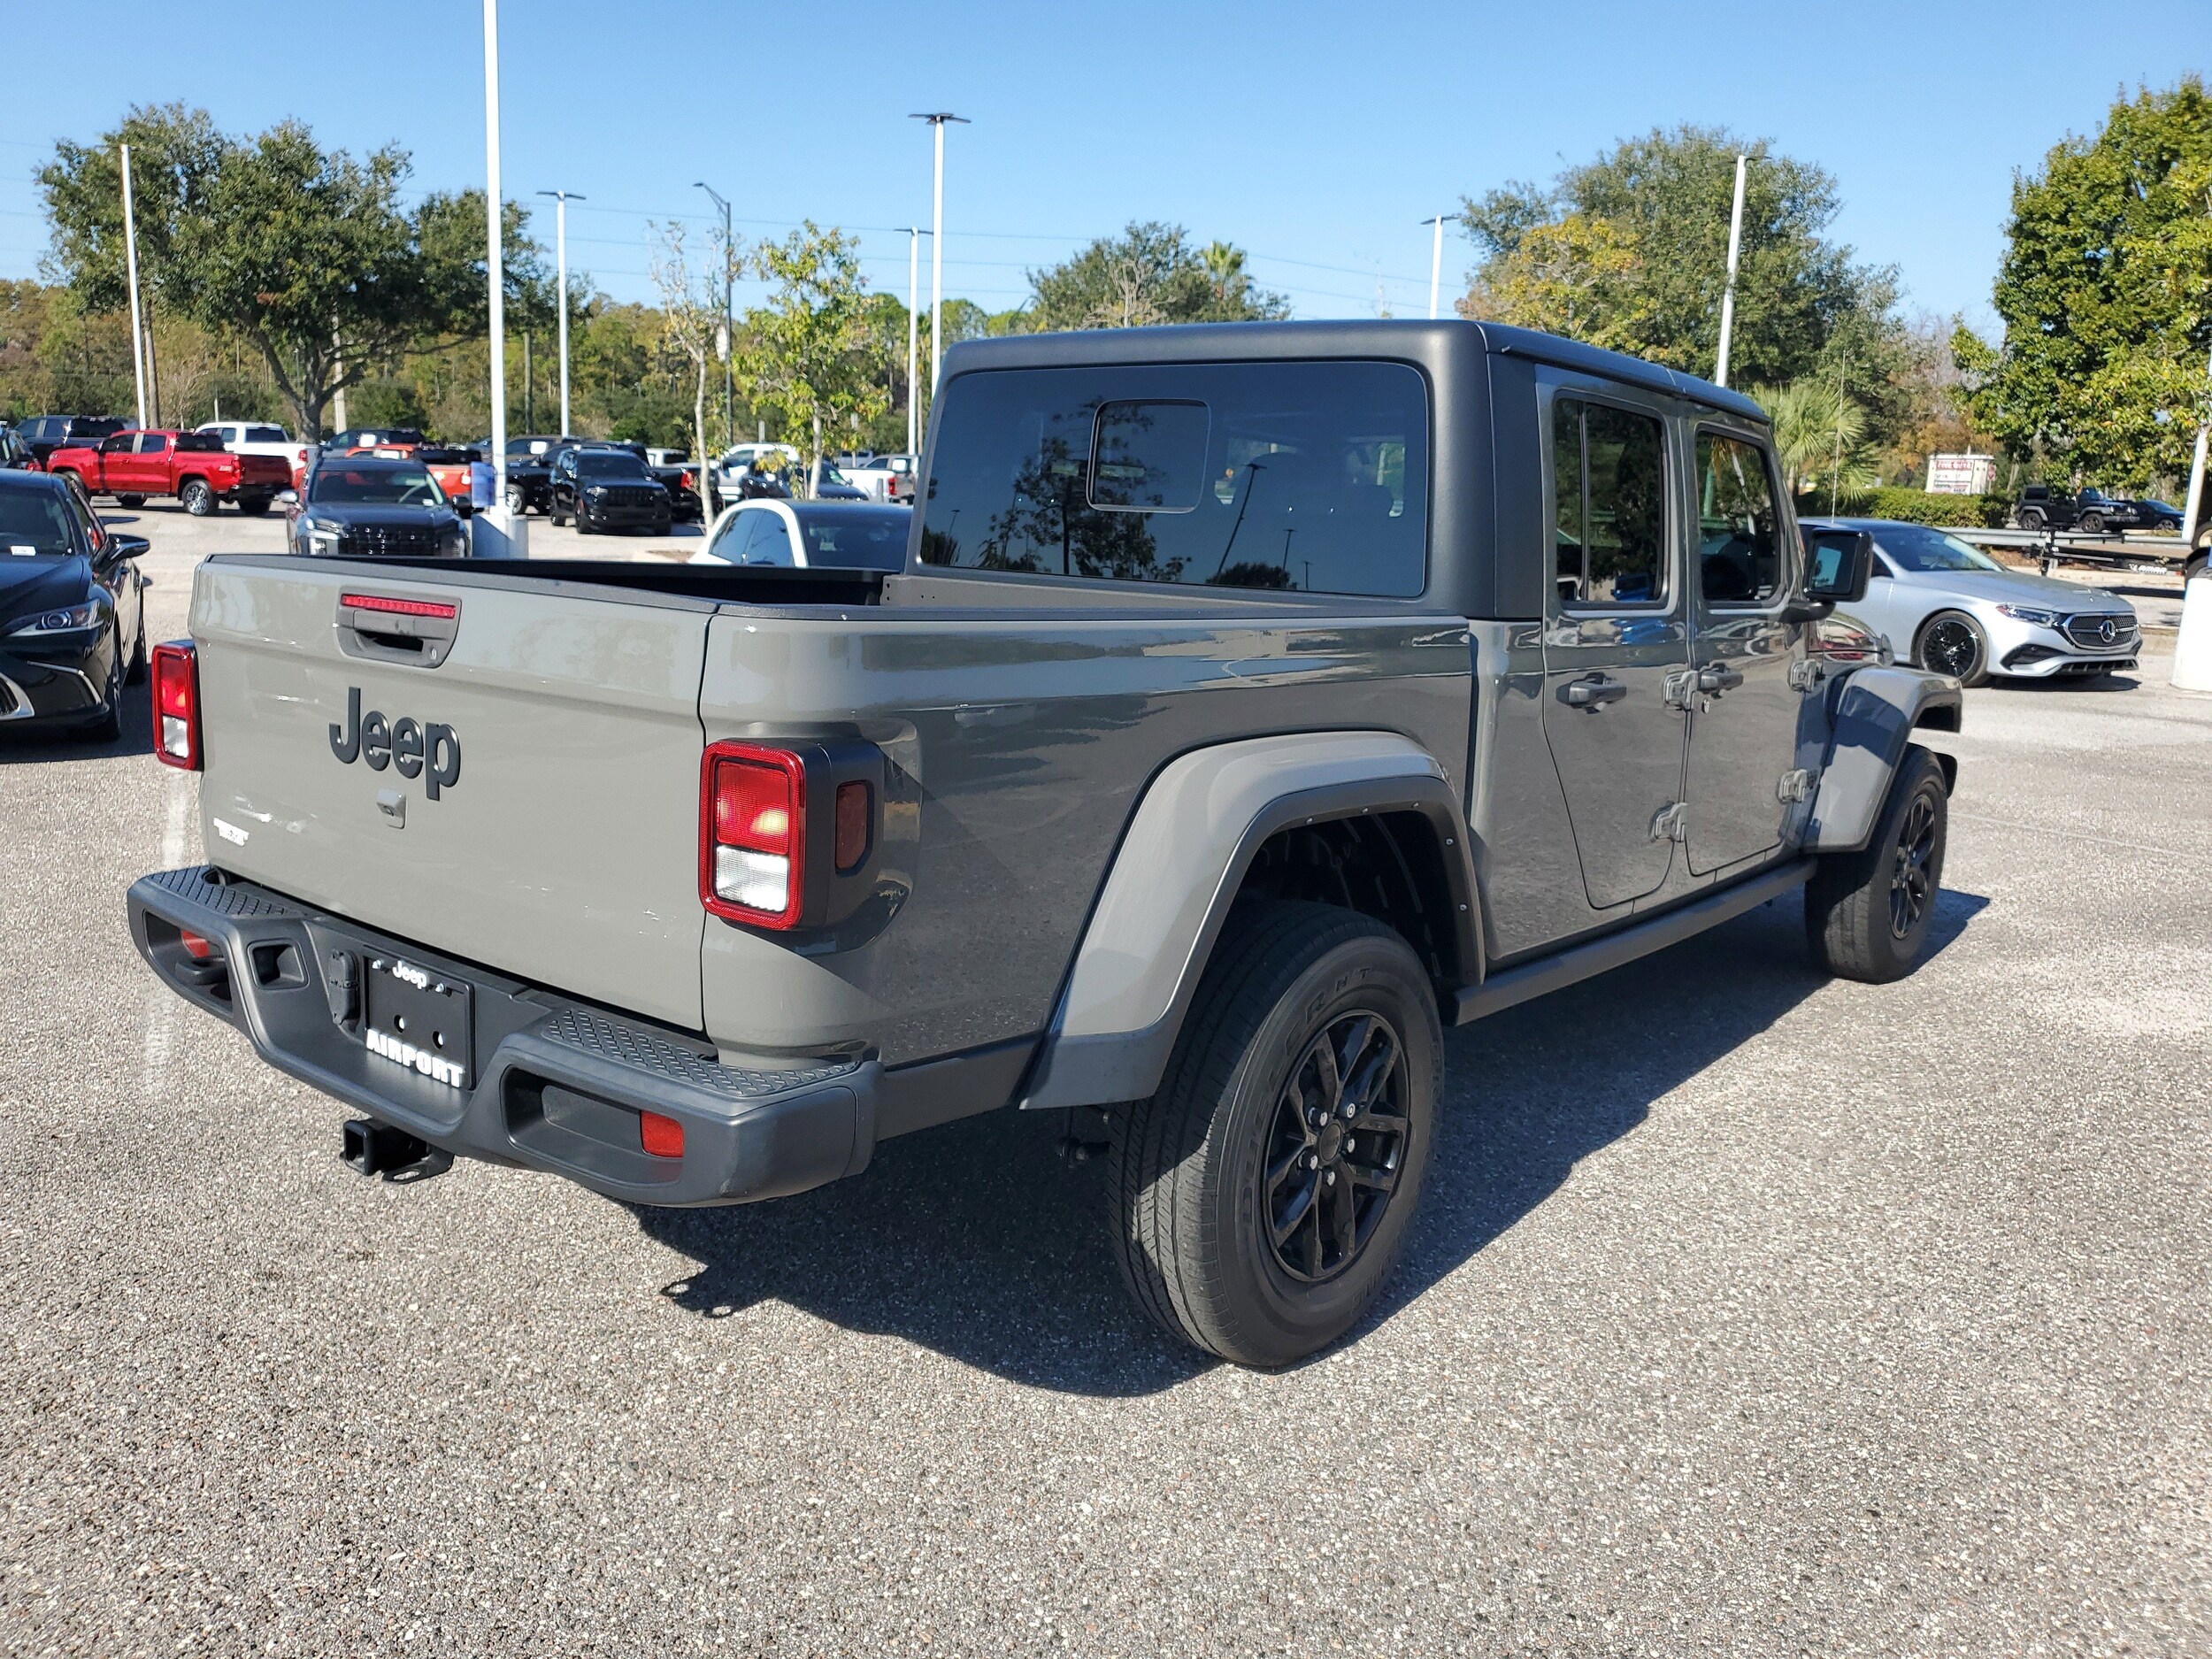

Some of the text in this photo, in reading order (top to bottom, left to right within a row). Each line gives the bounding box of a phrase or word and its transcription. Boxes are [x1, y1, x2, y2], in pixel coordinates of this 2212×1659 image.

[328, 686, 462, 803] Jeep
[392, 960, 429, 990] Jeep
[365, 1028, 465, 1088] AIRPORT
